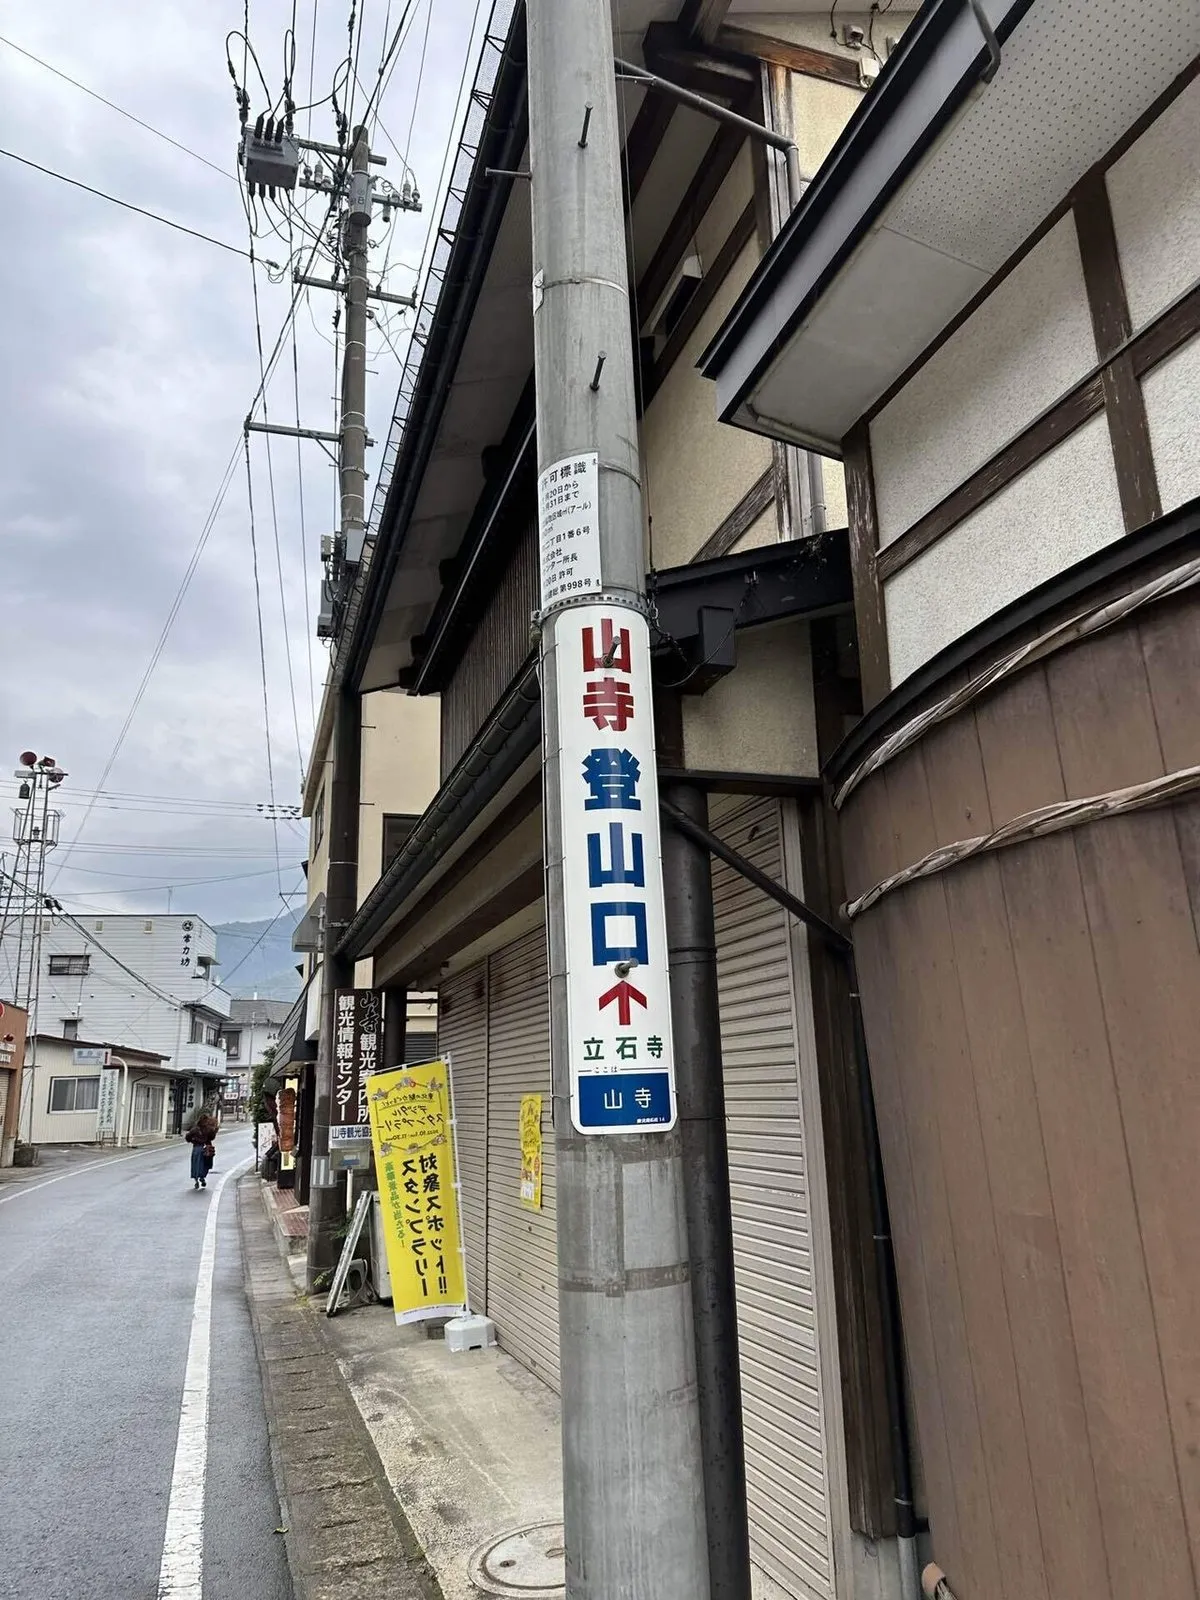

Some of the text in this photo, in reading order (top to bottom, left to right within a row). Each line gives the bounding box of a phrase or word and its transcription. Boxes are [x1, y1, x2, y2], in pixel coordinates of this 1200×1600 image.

[559, 567, 573, 581] 許可
[336, 995, 355, 1121] 観光情報センター
[583, 1035, 663, 1061] 立石寺
[594, 1066, 618, 1074] ここは
[604, 1088, 652, 1110] 山寺
